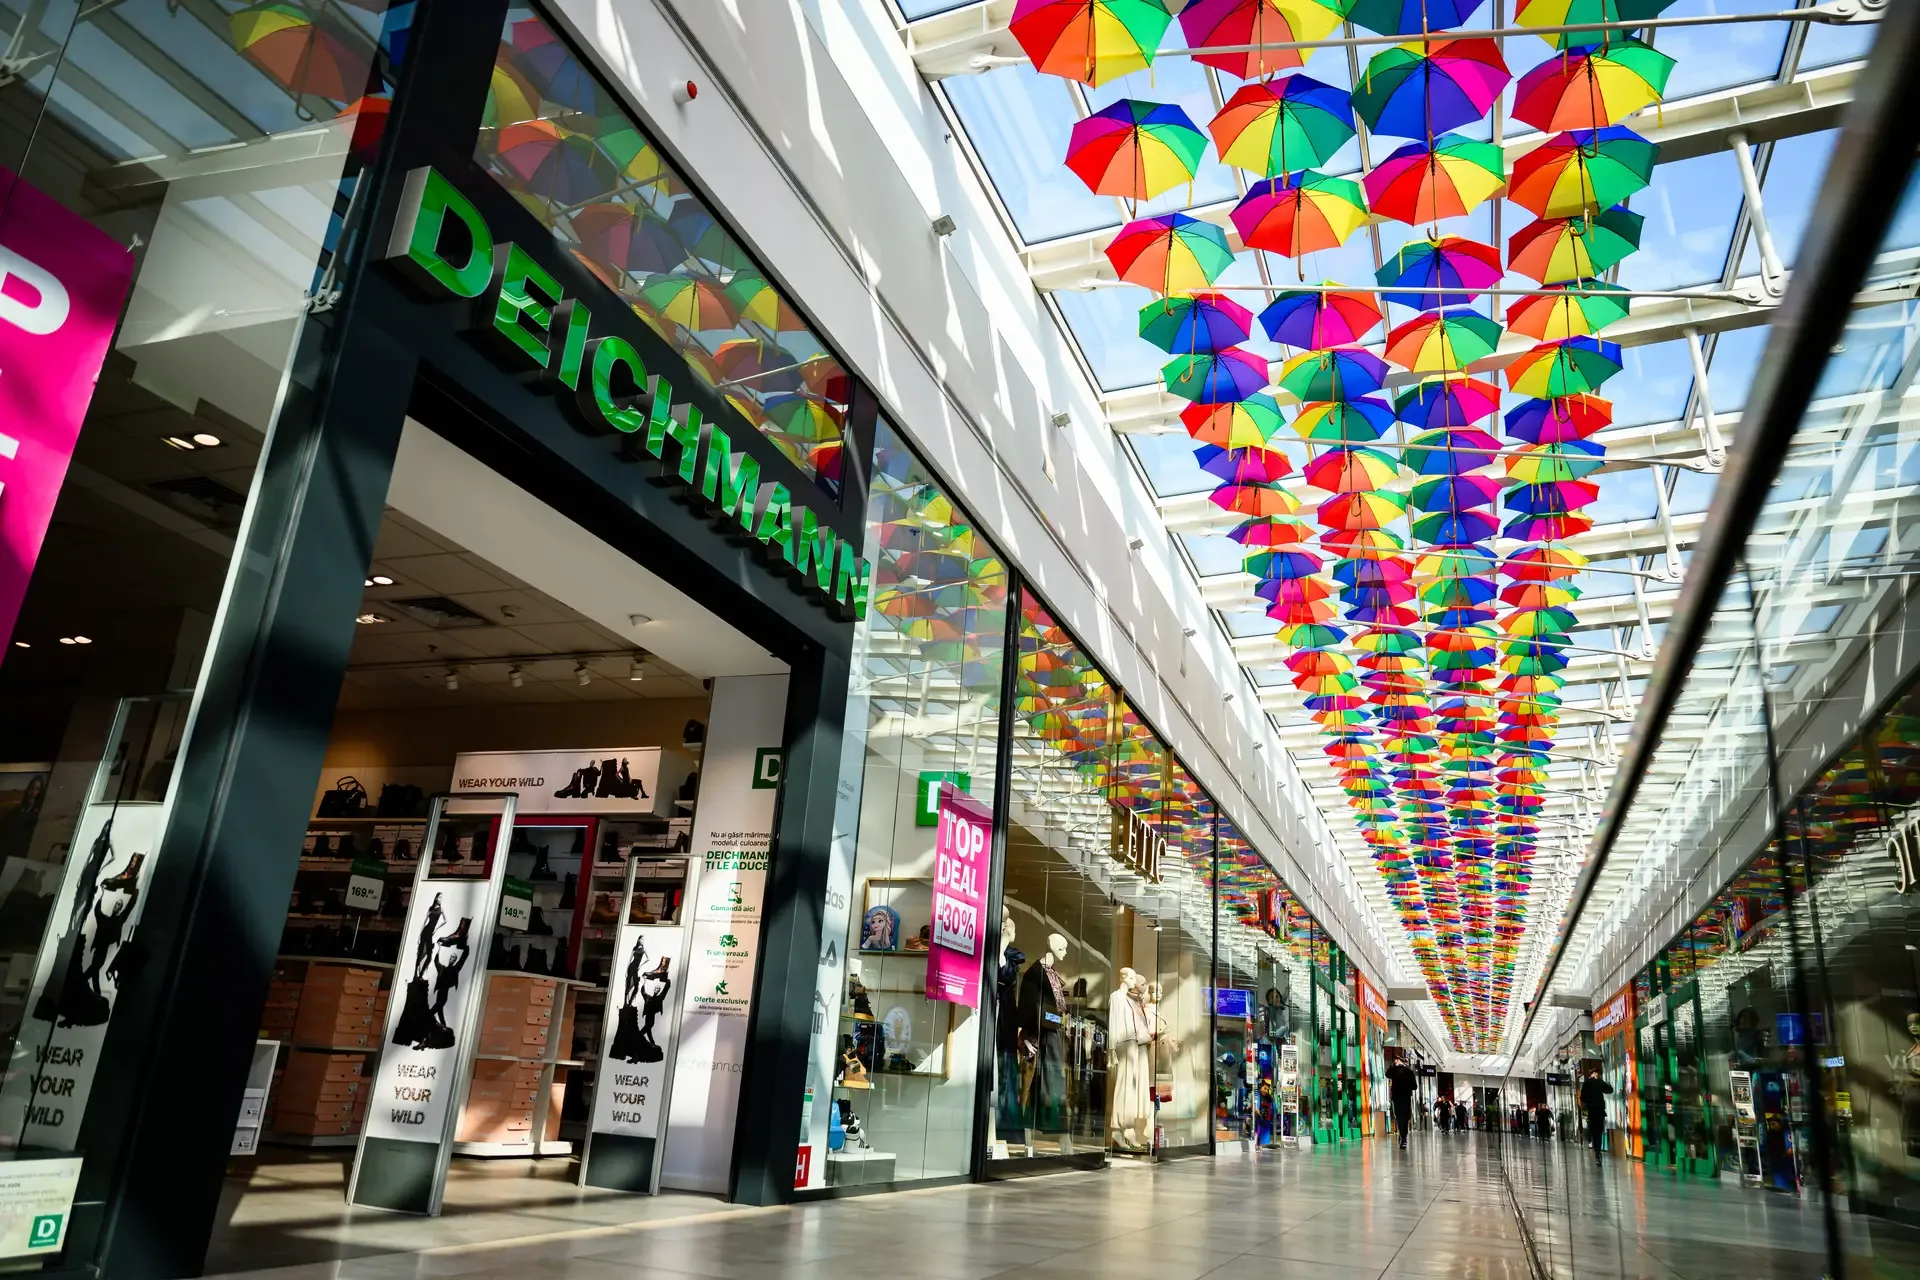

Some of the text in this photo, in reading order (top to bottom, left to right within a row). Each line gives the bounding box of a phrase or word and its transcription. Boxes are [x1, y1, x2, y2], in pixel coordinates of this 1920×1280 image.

[392, 165, 871, 621] DEICHMANN
[458, 777, 545, 788] WEAR YOUR WILD
[943, 809, 984, 862] TOP
[716, 861, 730, 871] LE
[731, 861, 769, 871] ADUCE
[938, 852, 979, 899] DEAL
[710, 904, 756, 912] Comandă aici
[693, 995, 749, 1005] Oferte exclusive
[35, 1045, 84, 1067] WEAR
[397, 1064, 437, 1080] WEAR
[614, 1074, 649, 1087] WEAR
[30, 1073, 75, 1097] YOUR
[394, 1086, 432, 1103] YOUR
[613, 1092, 646, 1106] YOUR
[23, 1104, 65, 1128] WILD
[391, 1108, 425, 1125] WILD
[612, 1110, 642, 1123] WILD
[37, 1218, 57, 1239] D
